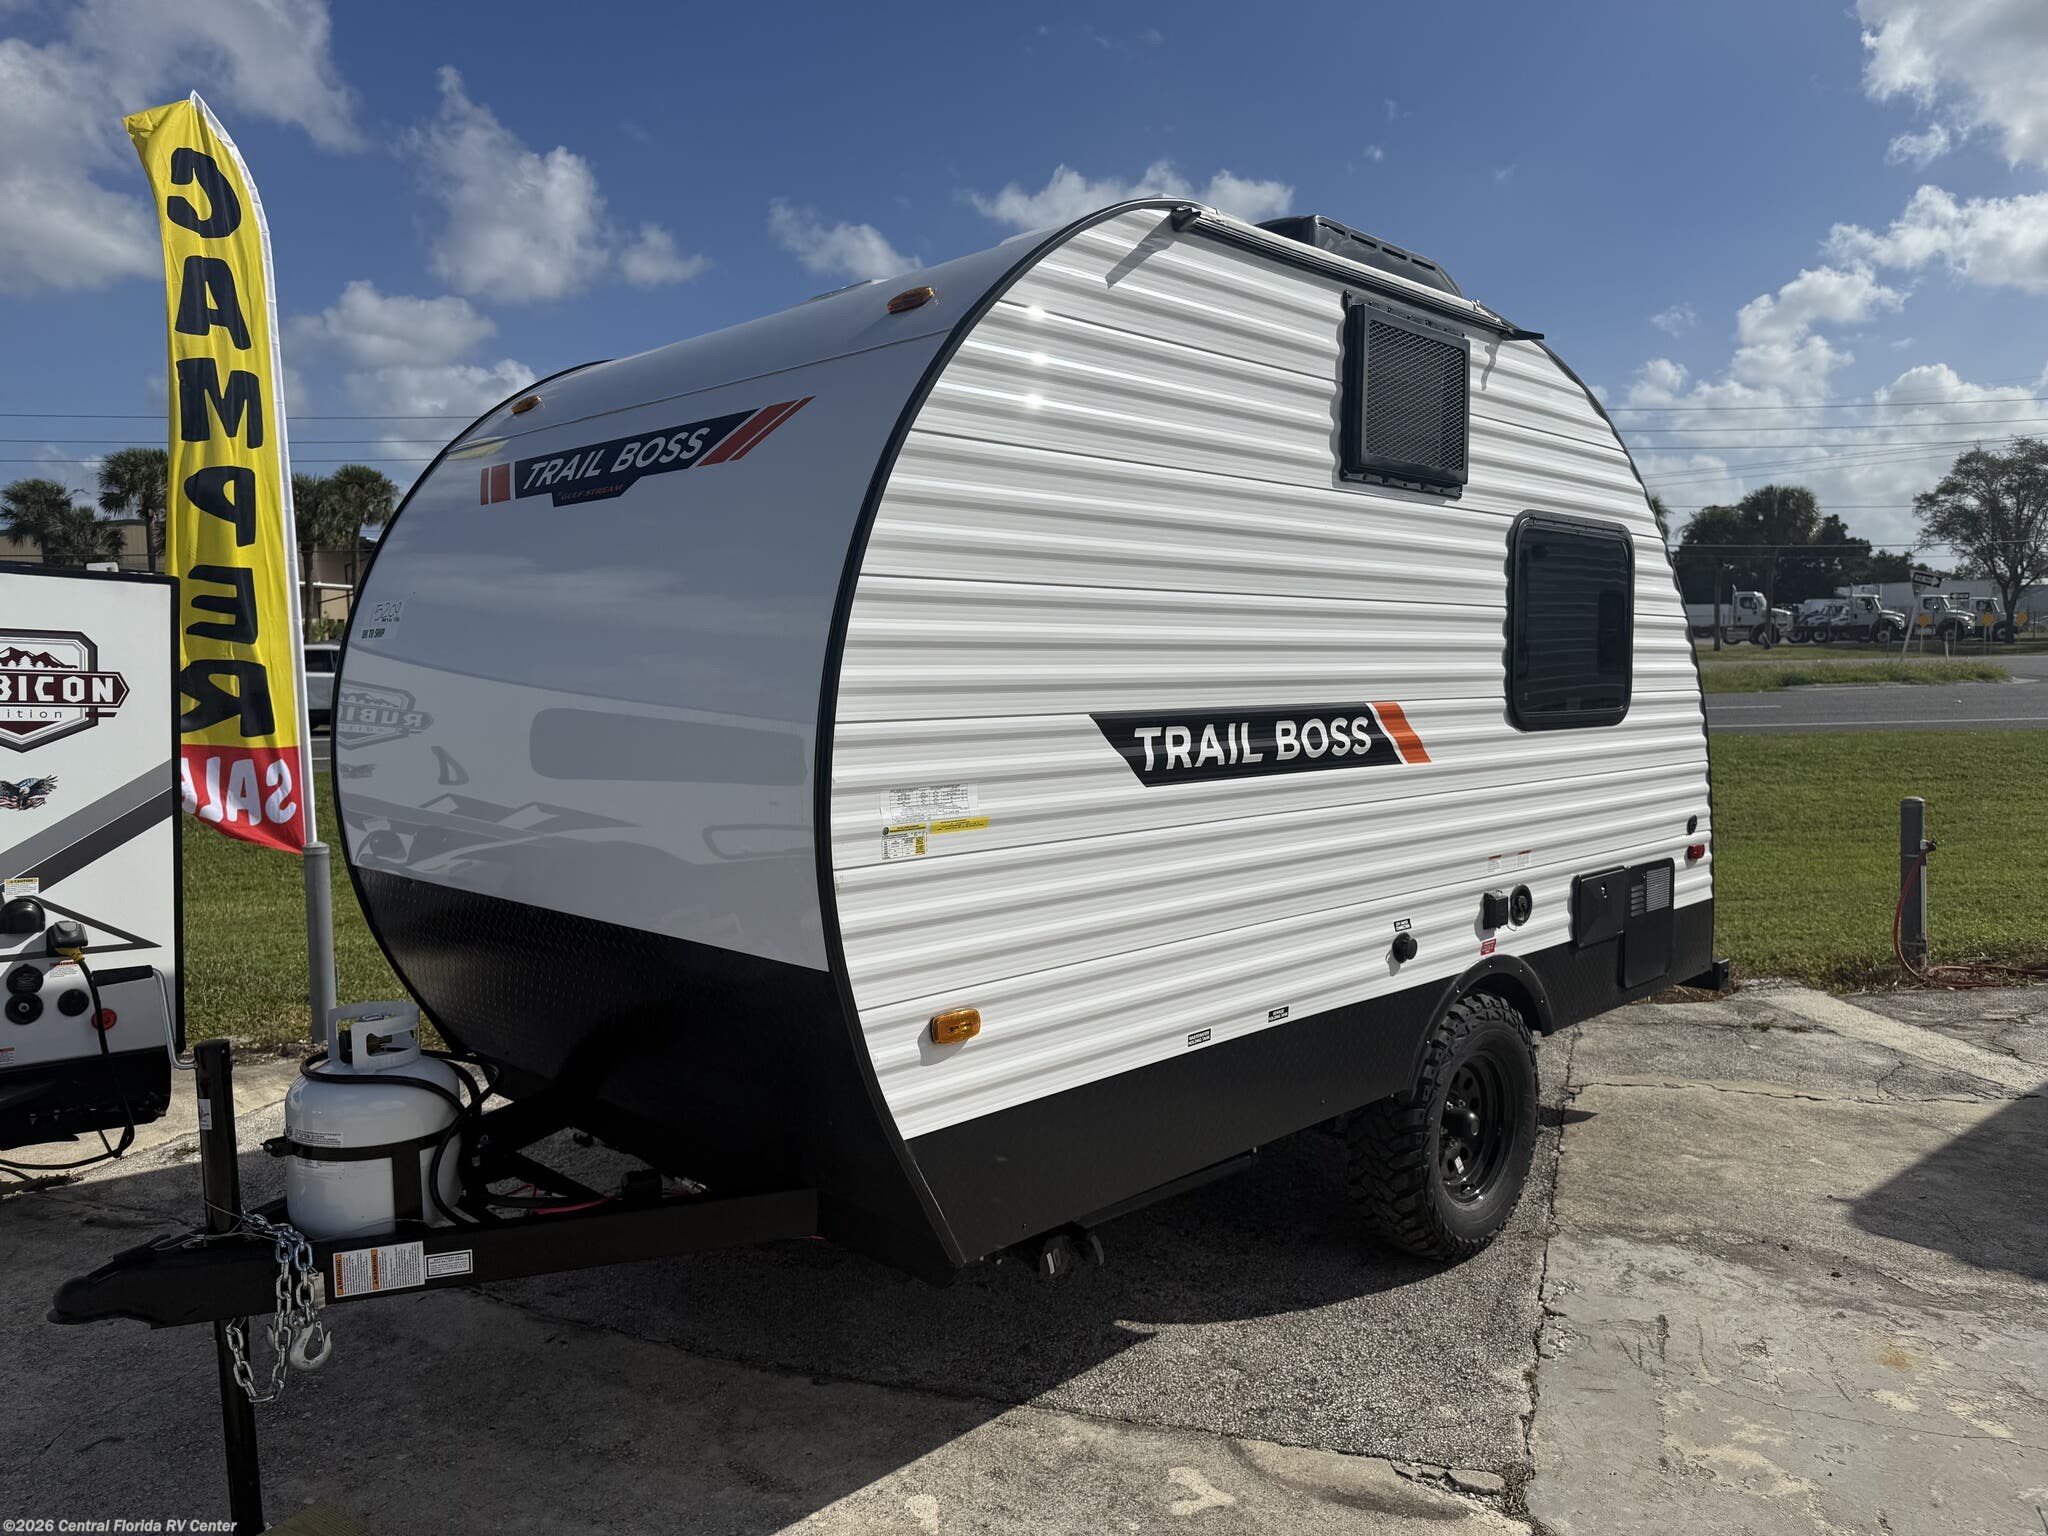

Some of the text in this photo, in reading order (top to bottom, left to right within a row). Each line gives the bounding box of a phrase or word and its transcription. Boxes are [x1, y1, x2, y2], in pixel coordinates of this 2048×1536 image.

[522, 427, 711, 490] TRAIL BOSS
[1134, 716, 1372, 772] TRAIL BOSS
